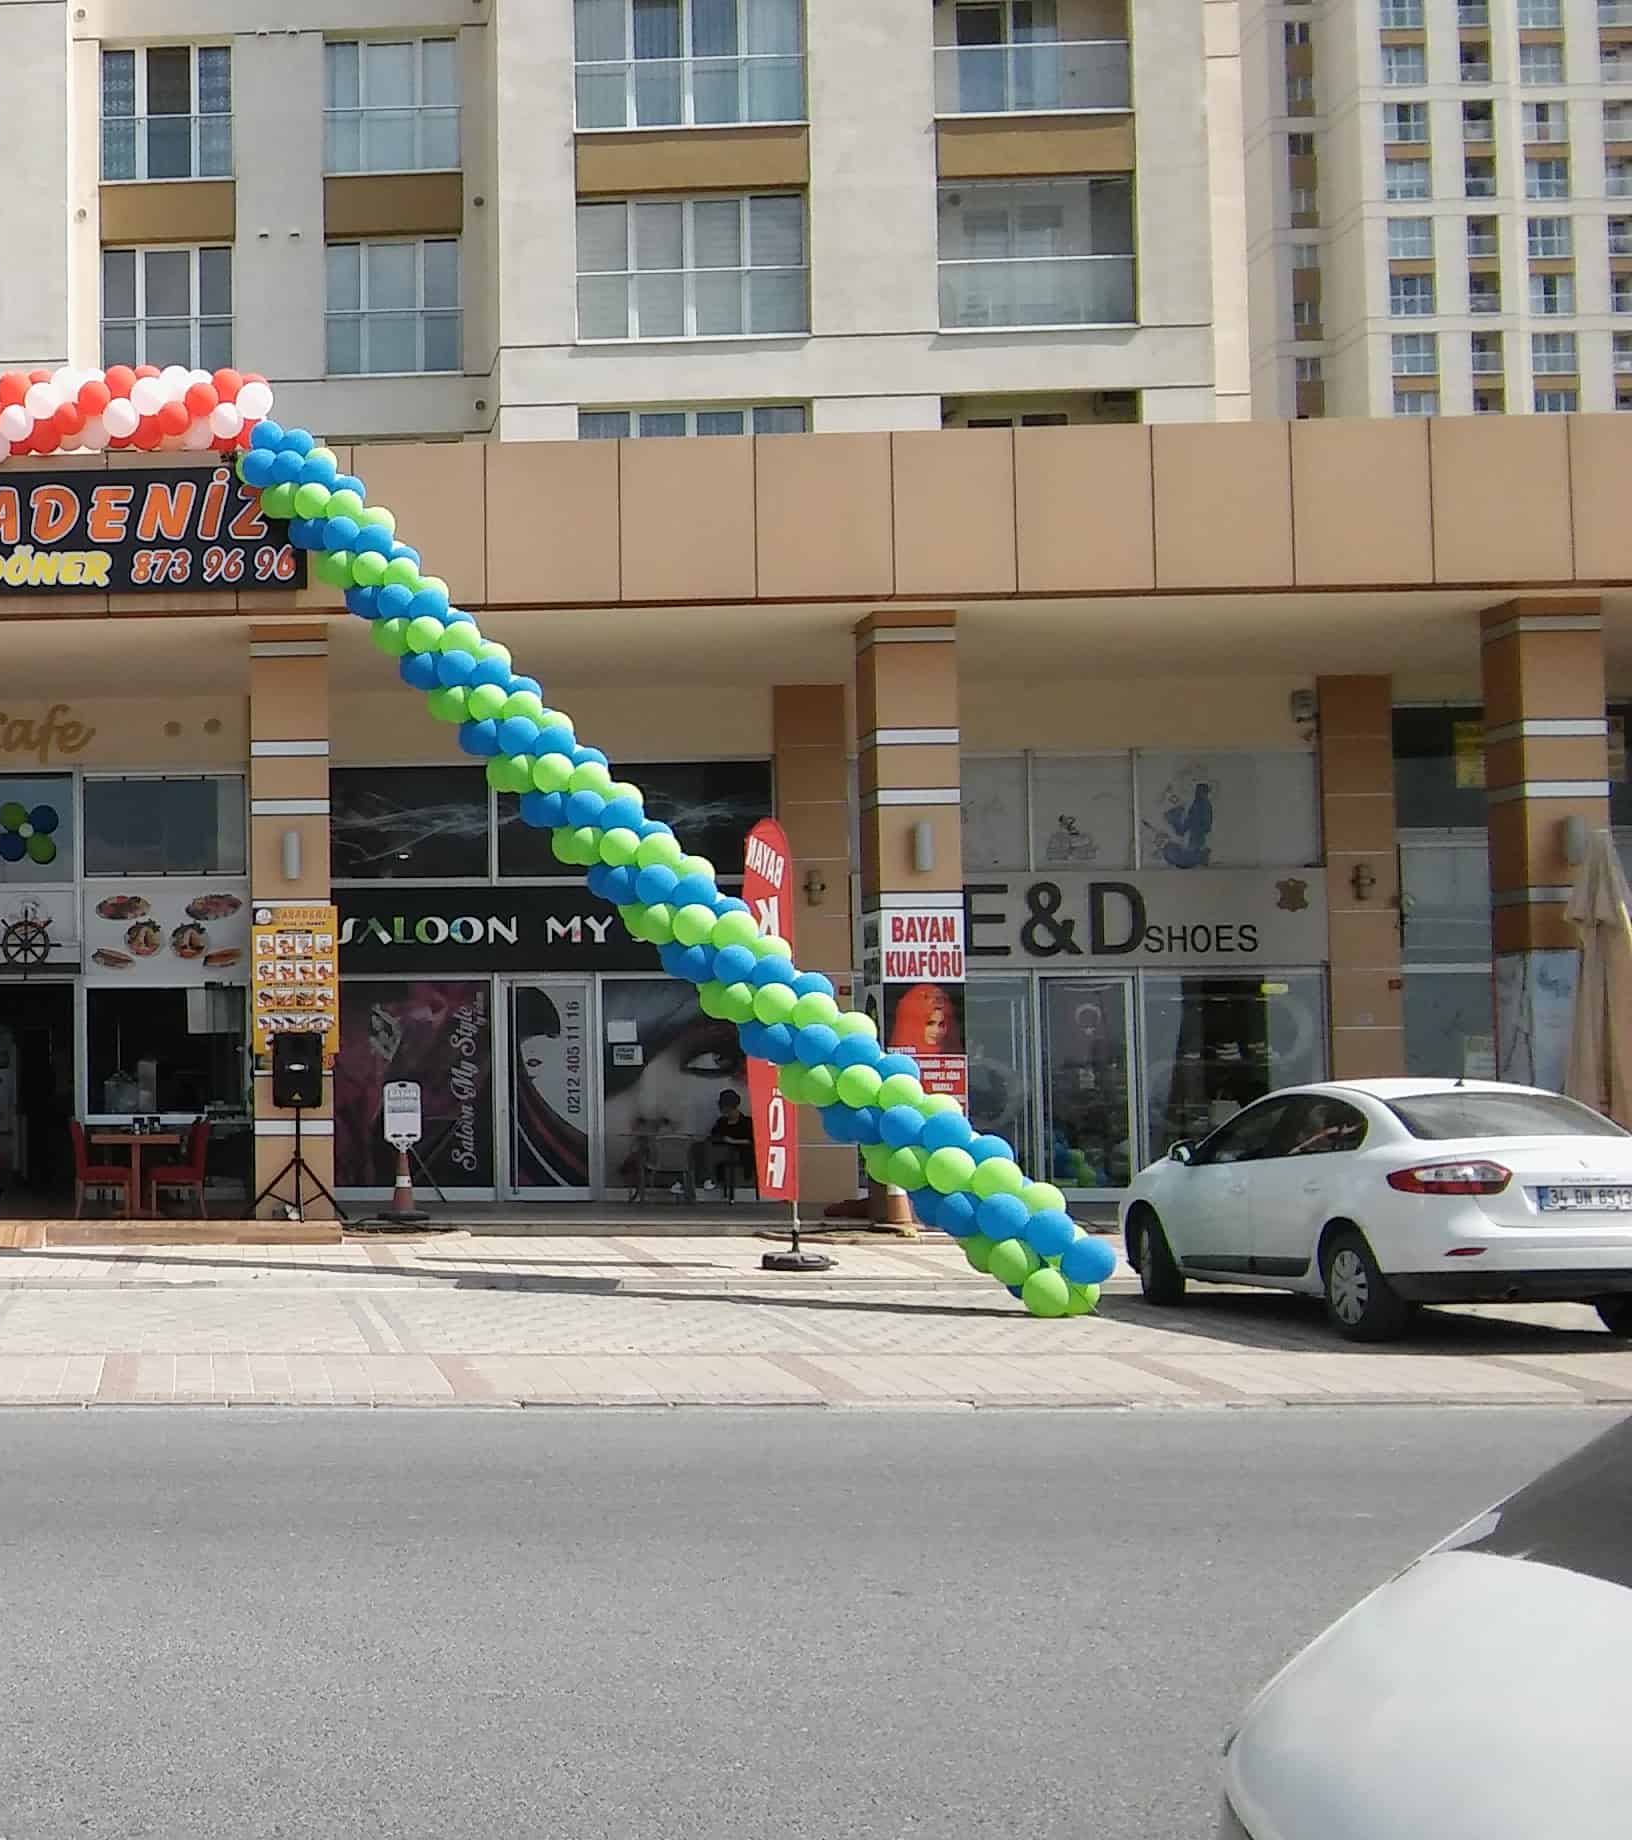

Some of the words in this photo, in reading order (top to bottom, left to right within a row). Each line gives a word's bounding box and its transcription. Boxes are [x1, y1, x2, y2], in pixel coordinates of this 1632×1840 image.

[131, 548, 192, 584] 873
[203, 546, 245, 582] 96
[254, 544, 297, 580] 96
[337, 915, 519, 945] SALOON
[545, 915, 614, 944] MY
[891, 916, 955, 943] BAYAN
[964, 882, 1147, 958] E&D
[1144, 924, 1259, 953] SHOES
[885, 944, 963, 978] KUAFÖRÜ
[1552, 1189, 1568, 1205] 34
